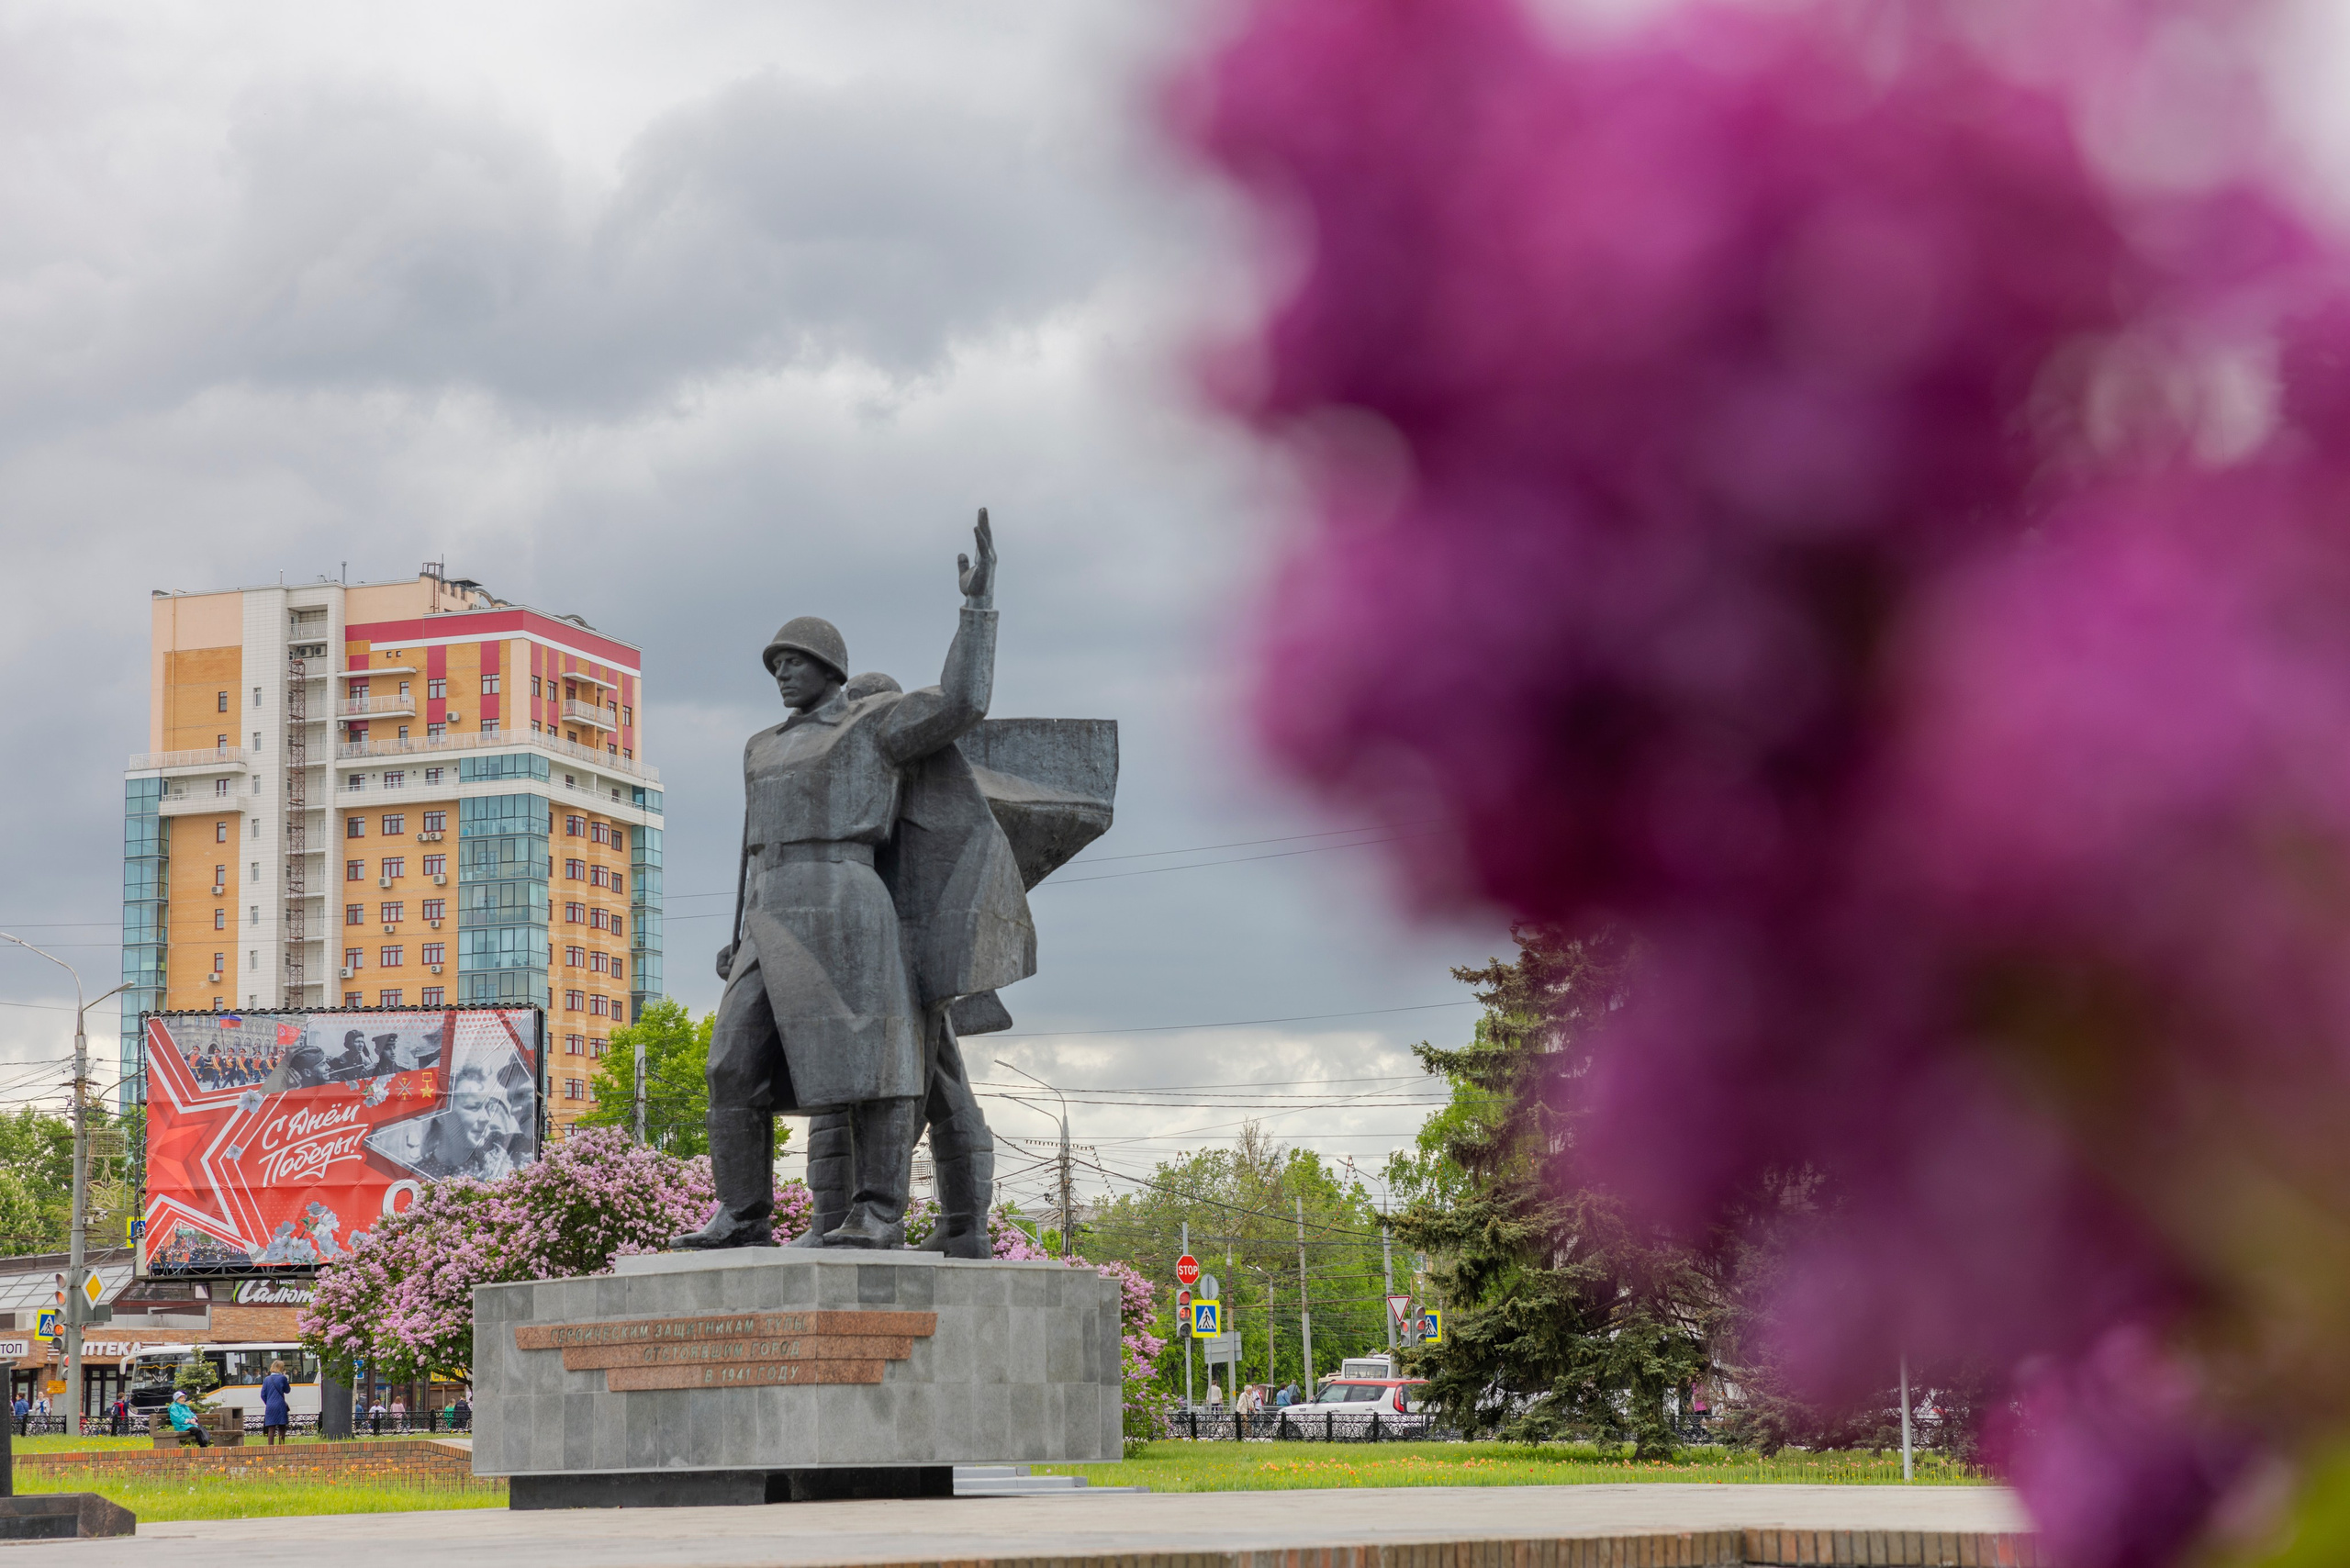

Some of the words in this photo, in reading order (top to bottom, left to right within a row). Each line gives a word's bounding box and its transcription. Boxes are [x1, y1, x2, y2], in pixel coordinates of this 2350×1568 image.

[262, 1113, 288, 1149] С
[285, 1103, 361, 1140] Днём
[258, 1126, 368, 1188] Победы!
[1178, 1265, 1198, 1275] STOP
[550, 1325, 648, 1342] ГЕРОИЧЕСКИМ
[655, 1318, 754, 1338] ЗАЩИТНИКАМ
[0, 1343, 22, 1354] ТОП
[81, 1341, 142, 1356] ПТЕКА
[644, 1343, 744, 1361] ОТСТОЯВШИМ
[751, 1340, 800, 1358] ГОРОД
[704, 1368, 713, 1383] В
[721, 1367, 751, 1382] 1941
[756, 1365, 800, 1383] ГОДУ
